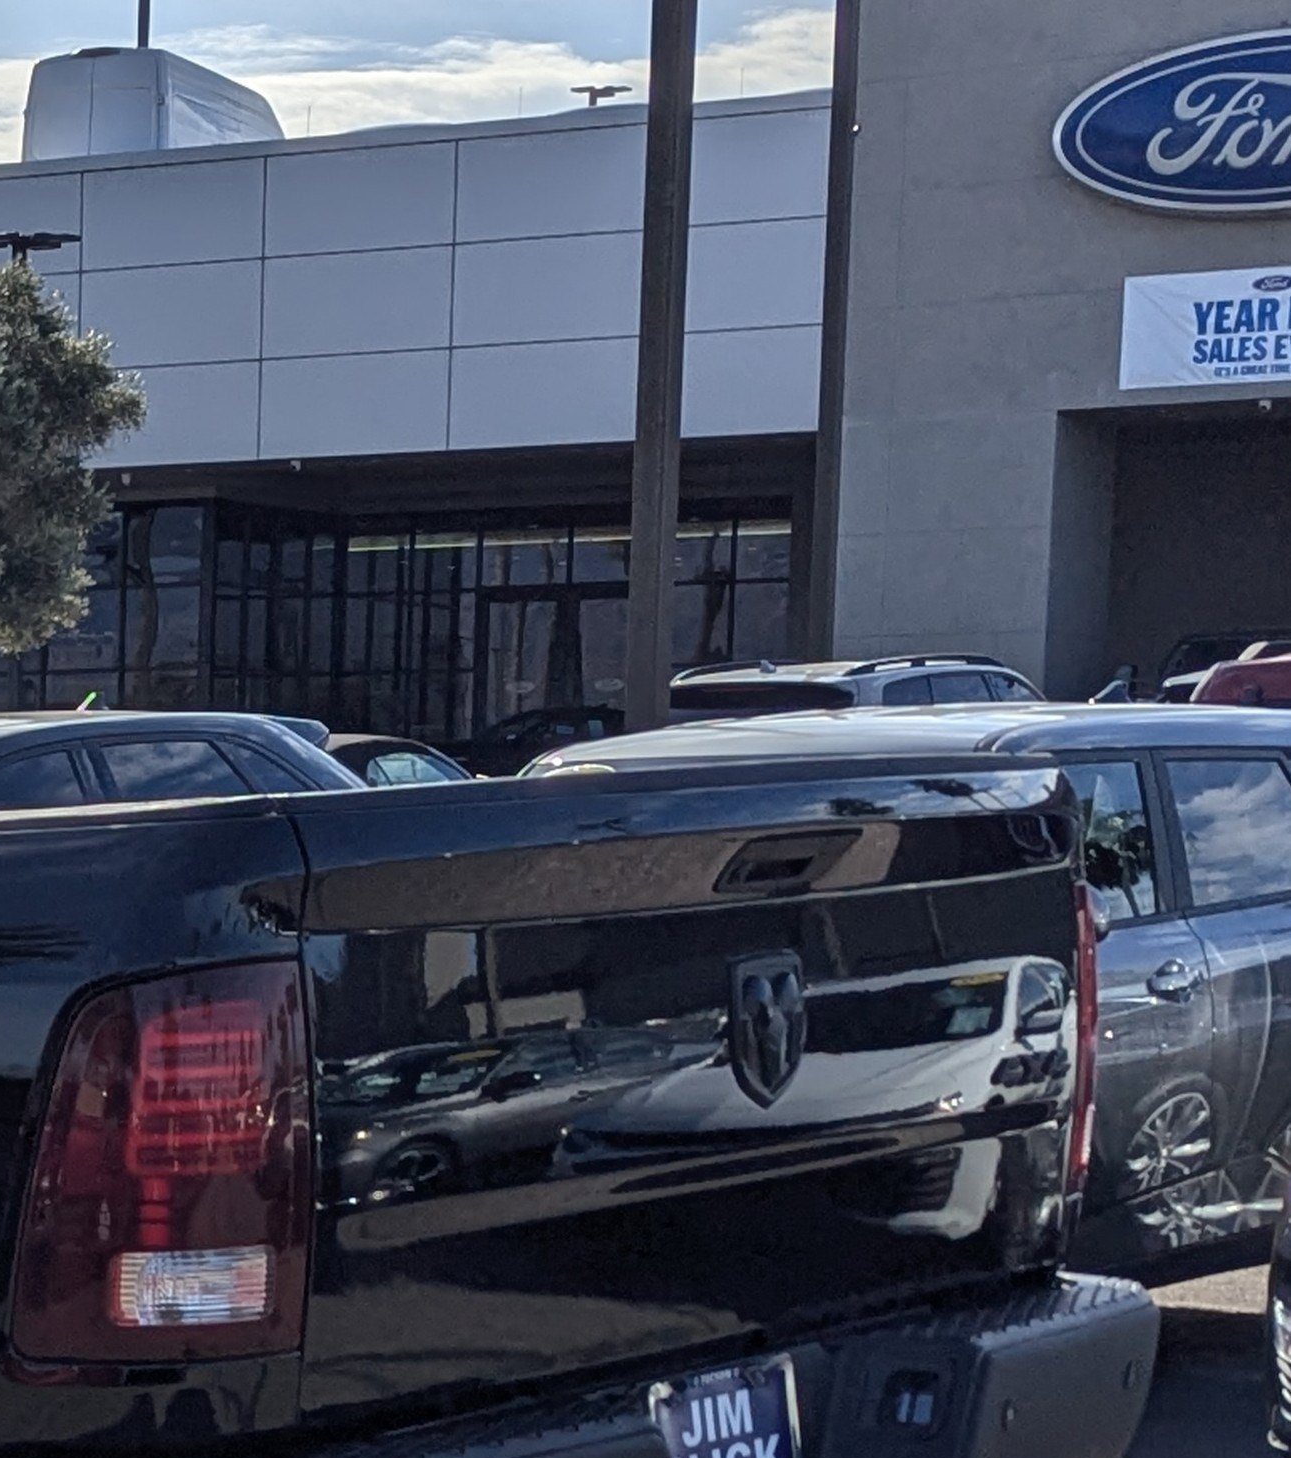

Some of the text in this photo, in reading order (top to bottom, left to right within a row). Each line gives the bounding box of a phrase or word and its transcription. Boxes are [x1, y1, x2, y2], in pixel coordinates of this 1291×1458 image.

[1193, 297, 1280, 335] YEAR
[1192, 335, 1268, 364] SALES
[682, 1388, 754, 1448] JIM
